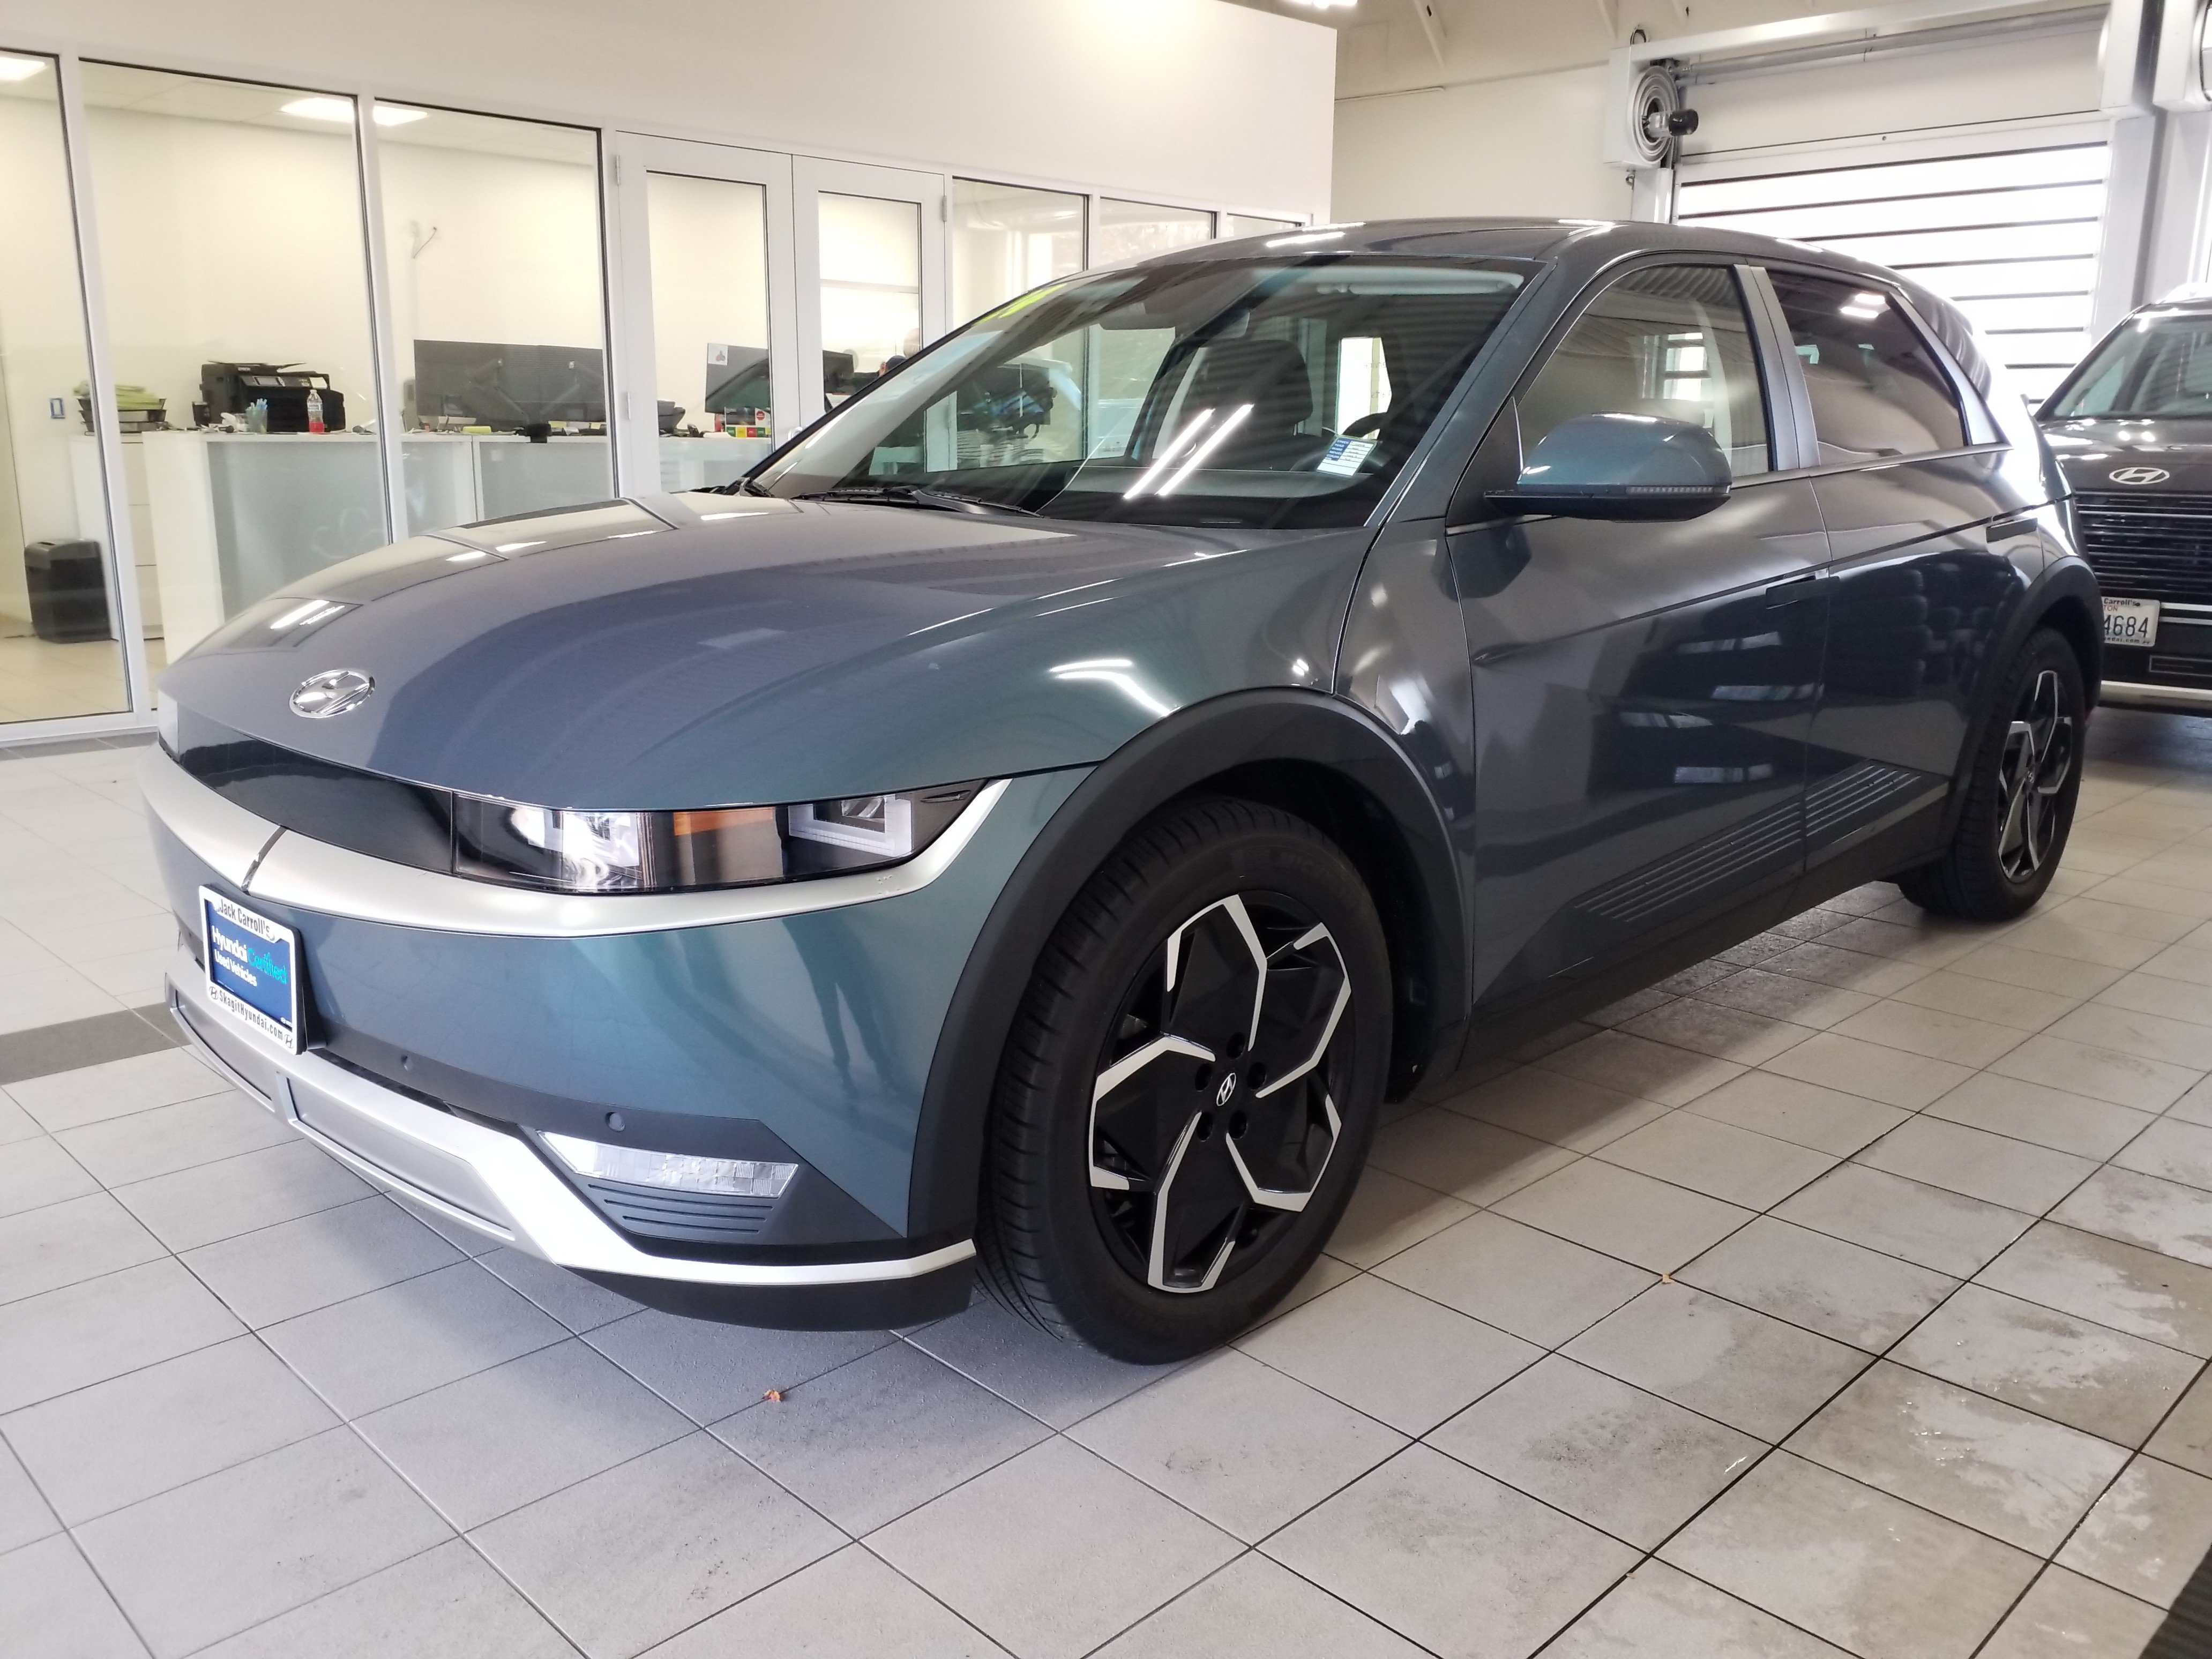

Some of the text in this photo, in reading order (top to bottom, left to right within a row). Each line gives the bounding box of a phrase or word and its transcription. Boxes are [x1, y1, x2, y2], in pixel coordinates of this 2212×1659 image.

[2104, 615, 2148, 638] 4684
[218, 899, 270, 938] Jack Carroll's
[212, 925, 287, 984] Hyundai Certified
[214, 948, 230, 970] Used
[230, 959, 257, 987] Vehicles
[219, 990, 282, 1040] SkagitHyundai.com
